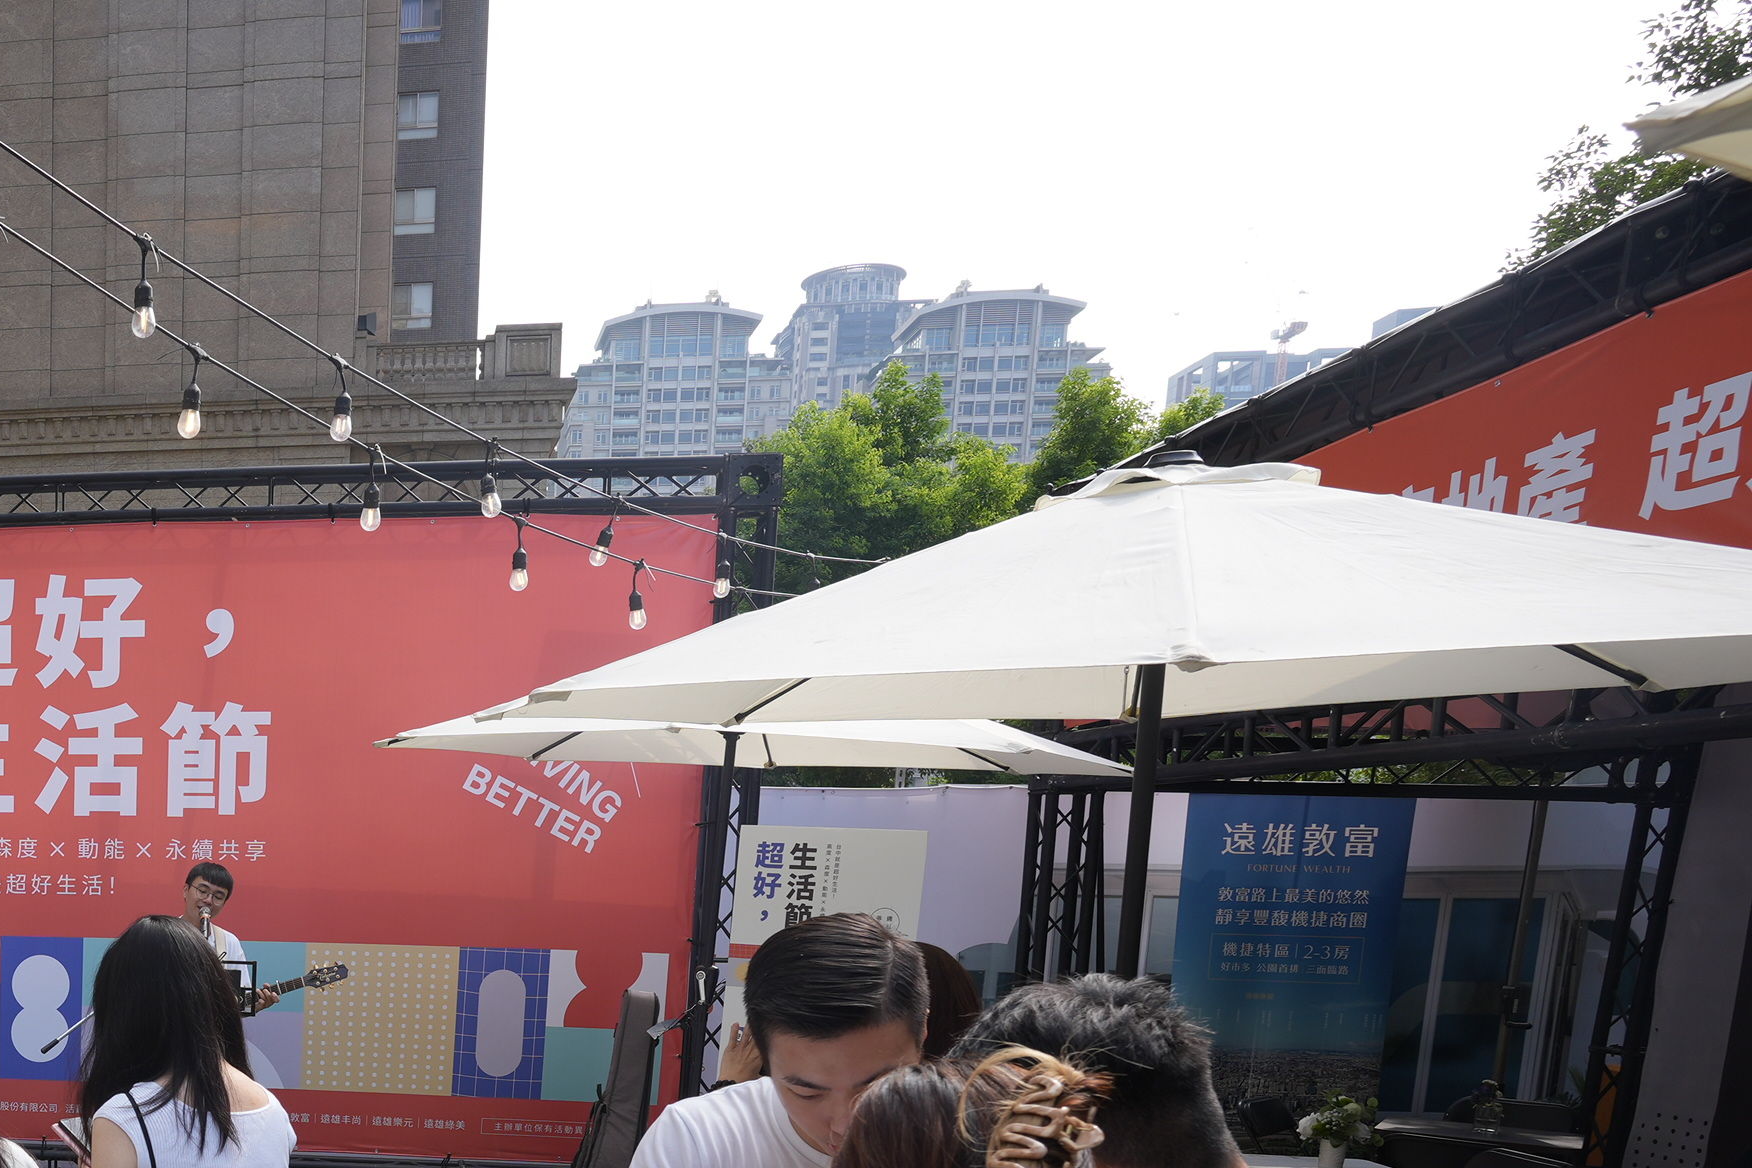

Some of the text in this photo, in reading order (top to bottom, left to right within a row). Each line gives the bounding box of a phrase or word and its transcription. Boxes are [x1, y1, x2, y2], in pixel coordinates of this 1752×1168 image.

[1639, 371, 1752, 521] 超
[462, 763, 602, 854] BETTER
[78, 838, 125, 860] 動能
[165, 838, 267, 862] 永續共享
[1221, 822, 1379, 858] 遠雄敦富
[1247, 863, 1352, 874] FORTUNE WEALTH
[784, 842, 818, 929] 生活節
[1218, 887, 1370, 906] 敦富路上最美的悠然
[1215, 908, 1368, 929] 靜享豐馥機捷商圈
[1222, 941, 1351, 961] 機捷特區 2-3房
[493, 1122, 593, 1135] 主辦單位保有活動異
